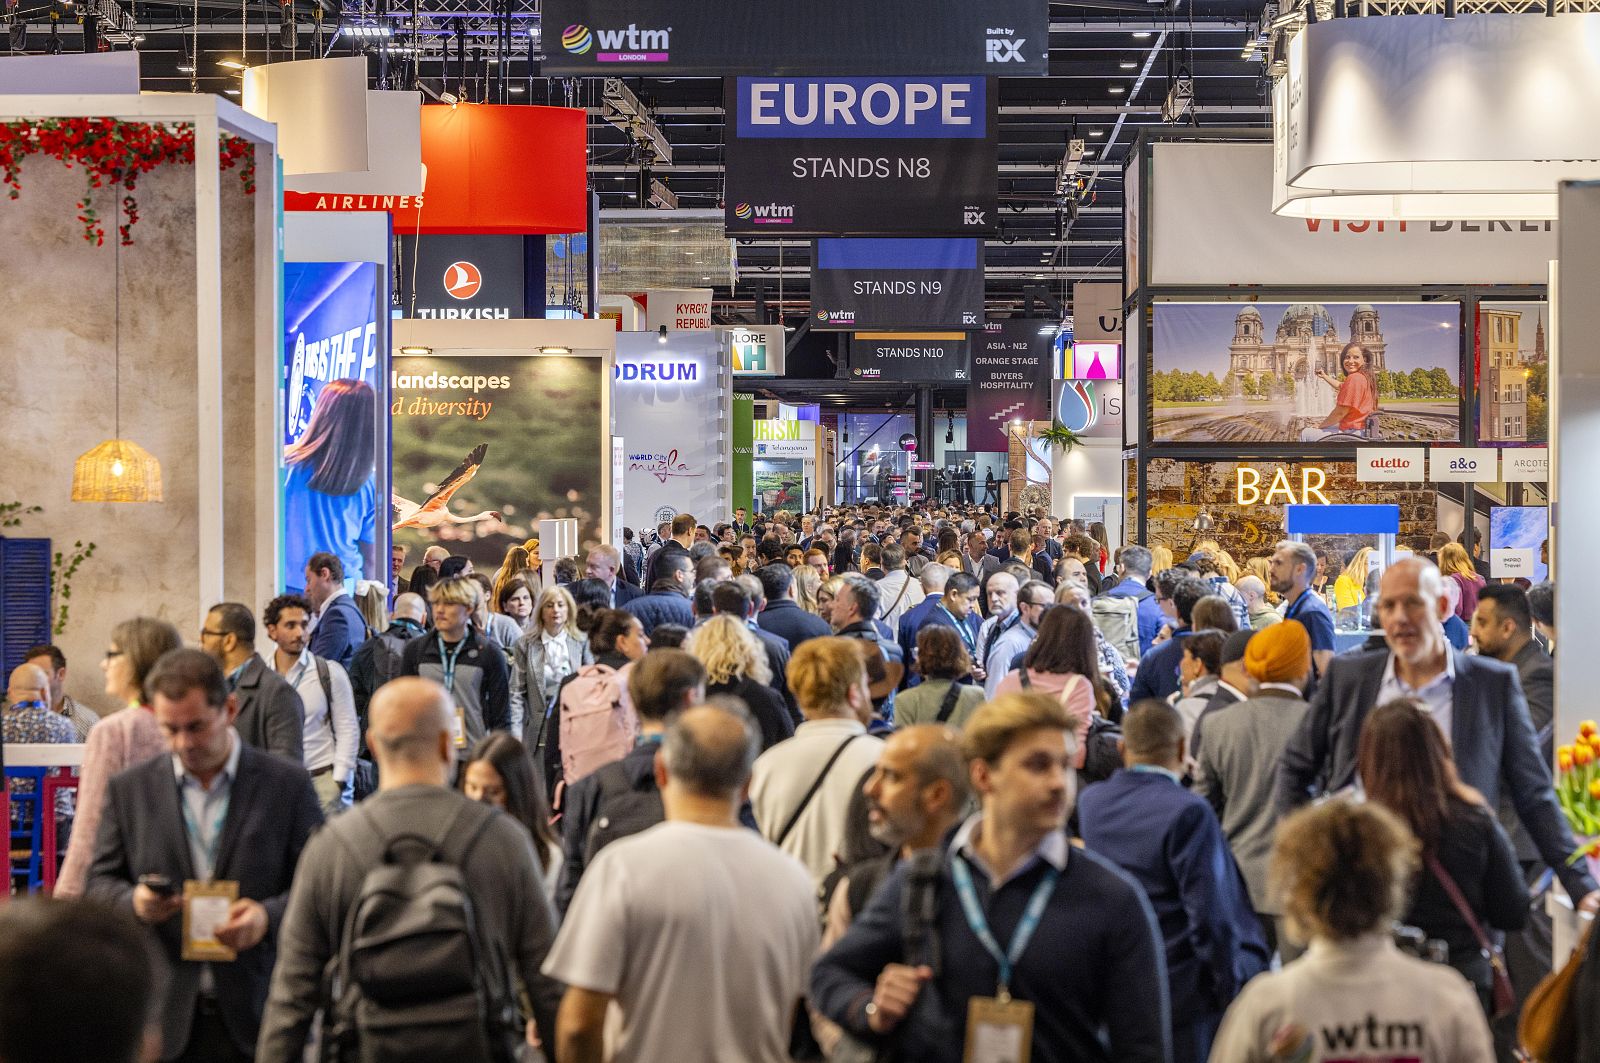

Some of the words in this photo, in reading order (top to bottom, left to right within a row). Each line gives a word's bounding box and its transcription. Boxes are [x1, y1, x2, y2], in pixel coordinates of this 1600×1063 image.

[597, 24, 670, 50] wtm
[1005, 28, 1014, 36] by
[986, 39, 1026, 62] RX
[751, 83, 972, 125] EUROPE
[792, 158, 890, 178] STANDS
[898, 158, 931, 178] N8
[315, 196, 424, 209] AIRLINES
[754, 202, 793, 217] wtm
[964, 212, 986, 225] RX
[853, 281, 916, 295] STANDS
[921, 281, 942, 295] N9
[418, 308, 509, 320] TURKISH
[676, 303, 708, 315] KYRGYZ
[830, 310, 855, 320] wtm
[732, 334, 767, 344] LORE
[876, 347, 920, 358] STANDS
[923, 347, 944, 358] N10
[616, 363, 697, 381] DRUM
[391, 371, 511, 393] landscapes
[408, 397, 493, 420] diversity
[1450, 457, 1477, 470] a&o
[1237, 467, 1332, 505] BAR
[1322, 1010, 1425, 1051] wtm
